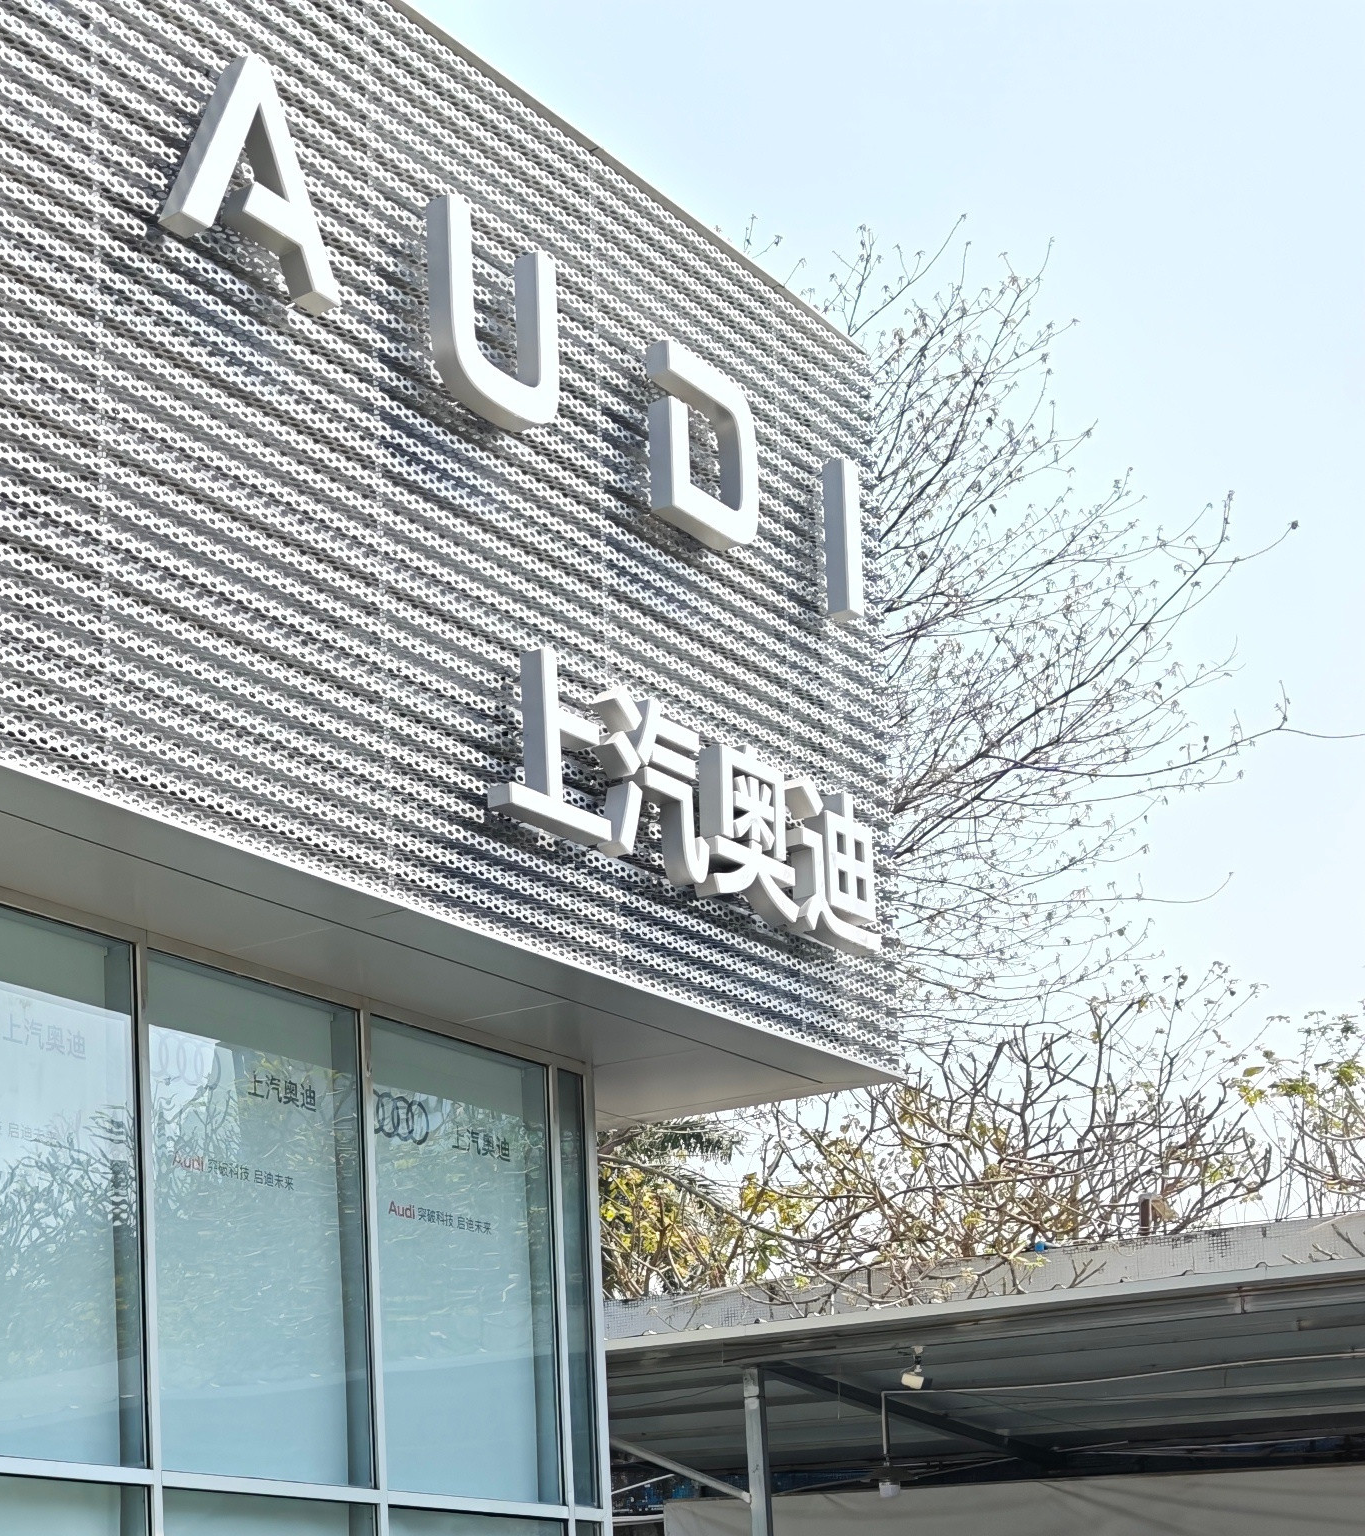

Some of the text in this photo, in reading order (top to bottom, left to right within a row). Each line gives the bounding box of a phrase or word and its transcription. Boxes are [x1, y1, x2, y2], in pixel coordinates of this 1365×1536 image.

[159, 53, 865, 623] AUDI
[487, 647, 880, 956] 上汽奥迪
[2, 1013, 87, 1060] 上汽奥迪
[247, 1070, 317, 1113] 上汽奥迪
[451, 1124, 511, 1163] 上汽奥迪
[172, 1150, 204, 1172] Audi
[253, 1169, 295, 1191] 启迪未来
[388, 1200, 416, 1220] Audi
[417, 1207, 454, 1228] 突破科技
